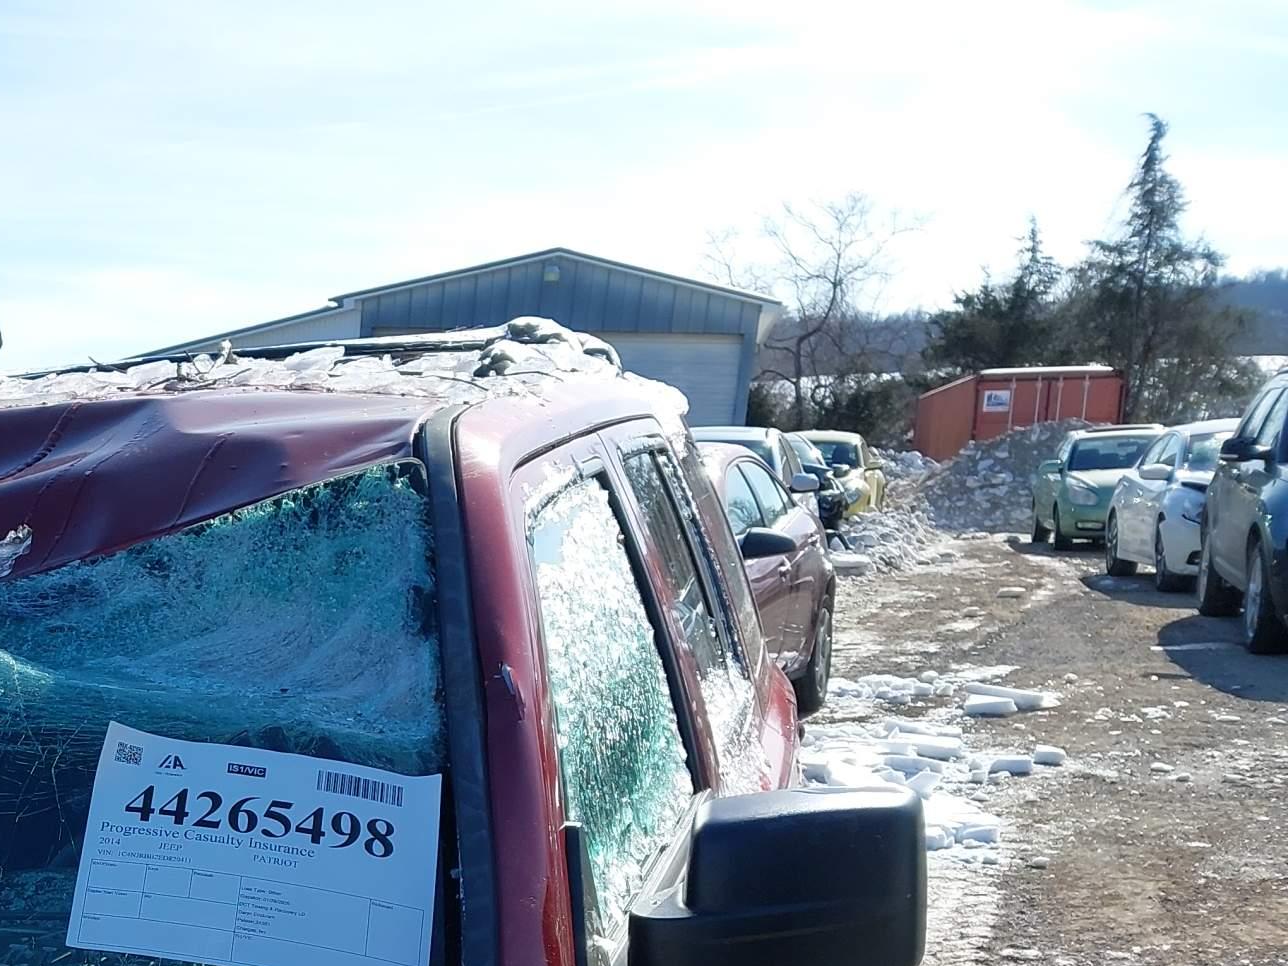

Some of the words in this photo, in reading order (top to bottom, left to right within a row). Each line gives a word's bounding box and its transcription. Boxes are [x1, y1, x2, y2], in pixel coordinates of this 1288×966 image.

[229, 763, 265, 777] IS1/VIC
[124, 784, 396, 858] 44265498
[99, 837, 121, 845] 2014
[100, 821, 180, 840] Progressive
[184, 829, 244, 849] Casualty
[249, 837, 316, 859] Insurance
[158, 842, 183, 852] JEEP
[253, 854, 298, 868] PATRIOT
